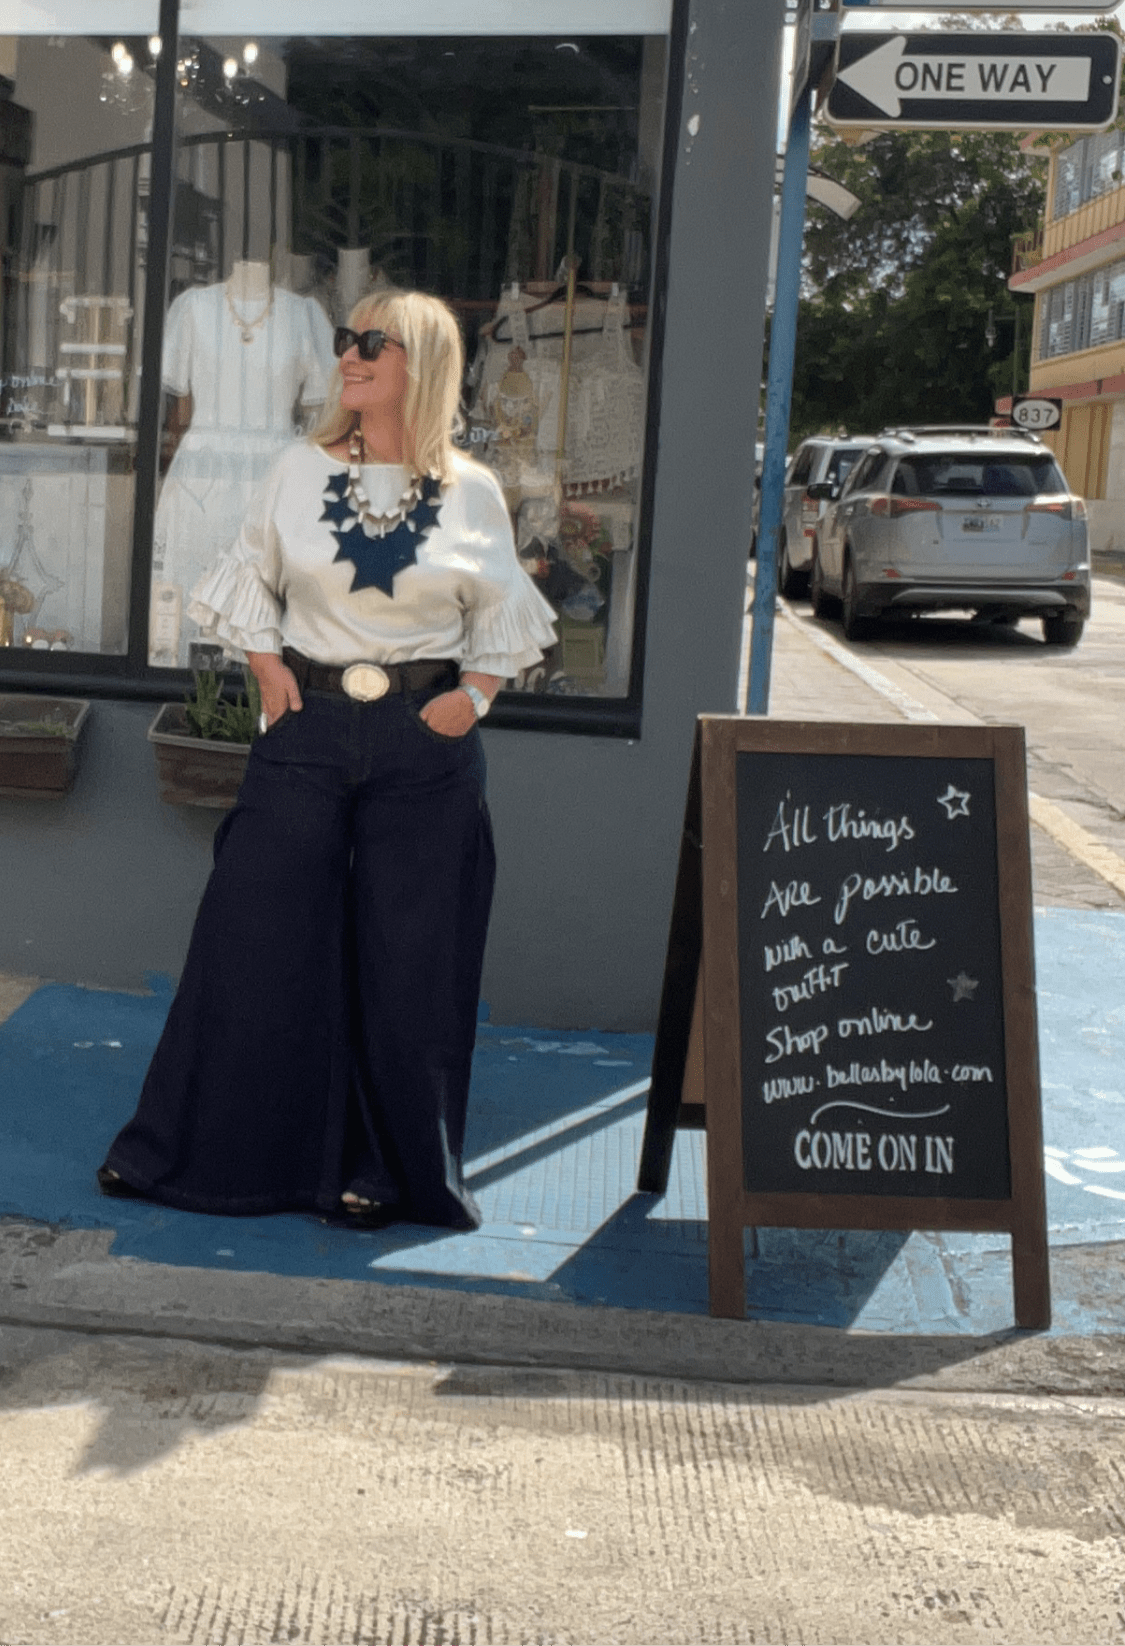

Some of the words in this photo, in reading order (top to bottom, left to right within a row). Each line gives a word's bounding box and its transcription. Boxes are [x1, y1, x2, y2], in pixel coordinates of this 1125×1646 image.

[895, 62, 965, 91] ONE
[978, 63, 1057, 93] WAY
[1019, 408, 1053, 423] 837
[763, 800, 817, 852] All
[823, 803, 915, 852] things
[834, 866, 959, 925] possible
[764, 935, 813, 972] with
[822, 938, 847, 954] a
[866, 919, 936, 955] cute
[765, 1025, 828, 1063] Shop
[838, 1006, 933, 1038] online
[794, 1129, 872, 1171] COME
[878, 1133, 917, 1172] ON
[924, 1135, 954, 1174] IN
